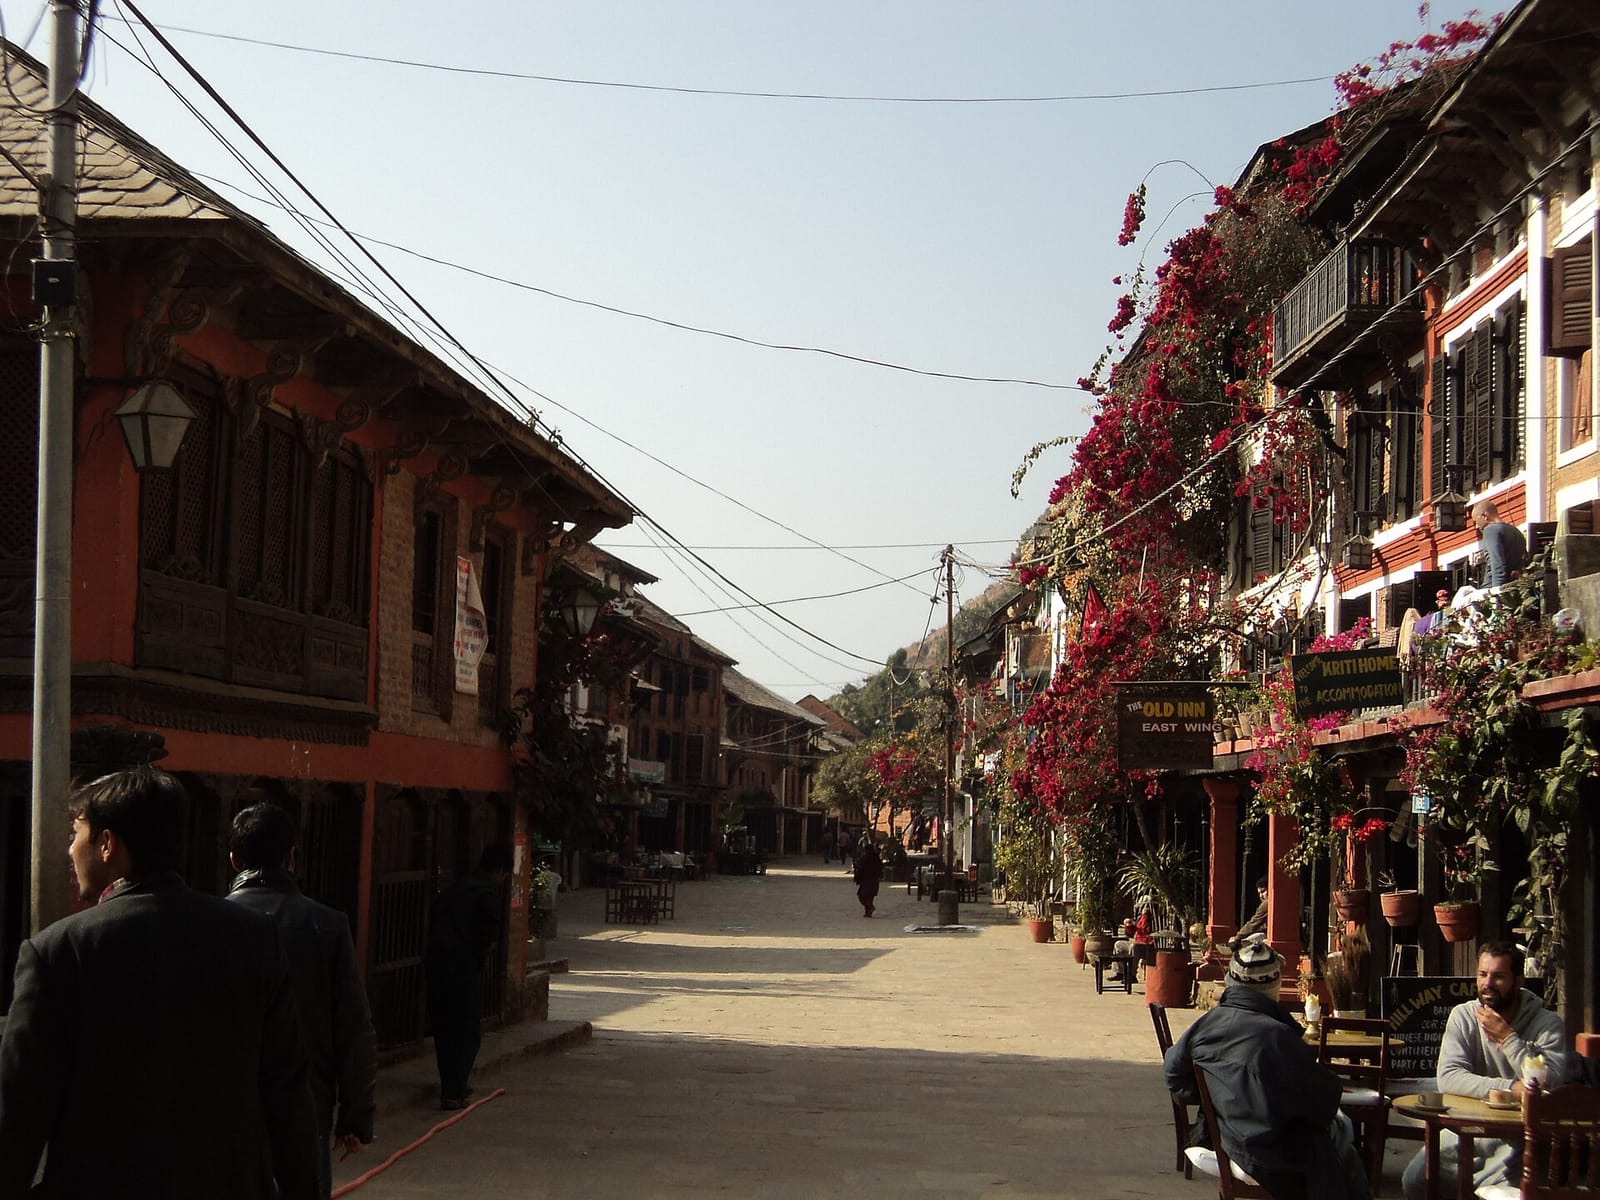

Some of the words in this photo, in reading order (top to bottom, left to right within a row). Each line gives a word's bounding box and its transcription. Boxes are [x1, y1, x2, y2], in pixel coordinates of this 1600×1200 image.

[1298, 685, 1309, 694] TO
[1316, 682, 1402, 702] ACCOMMODATION
[1126, 701, 1144, 712] THE
[1143, 701, 1175, 718] OLD
[1177, 701, 1206, 718] INN
[1142, 723, 1178, 732] EAST
[1184, 723, 1222, 732] WING
[1389, 1002, 1414, 1031] HILL
[1408, 985, 1442, 1009] WAY
[1391, 1059, 1417, 1070] PARTY
